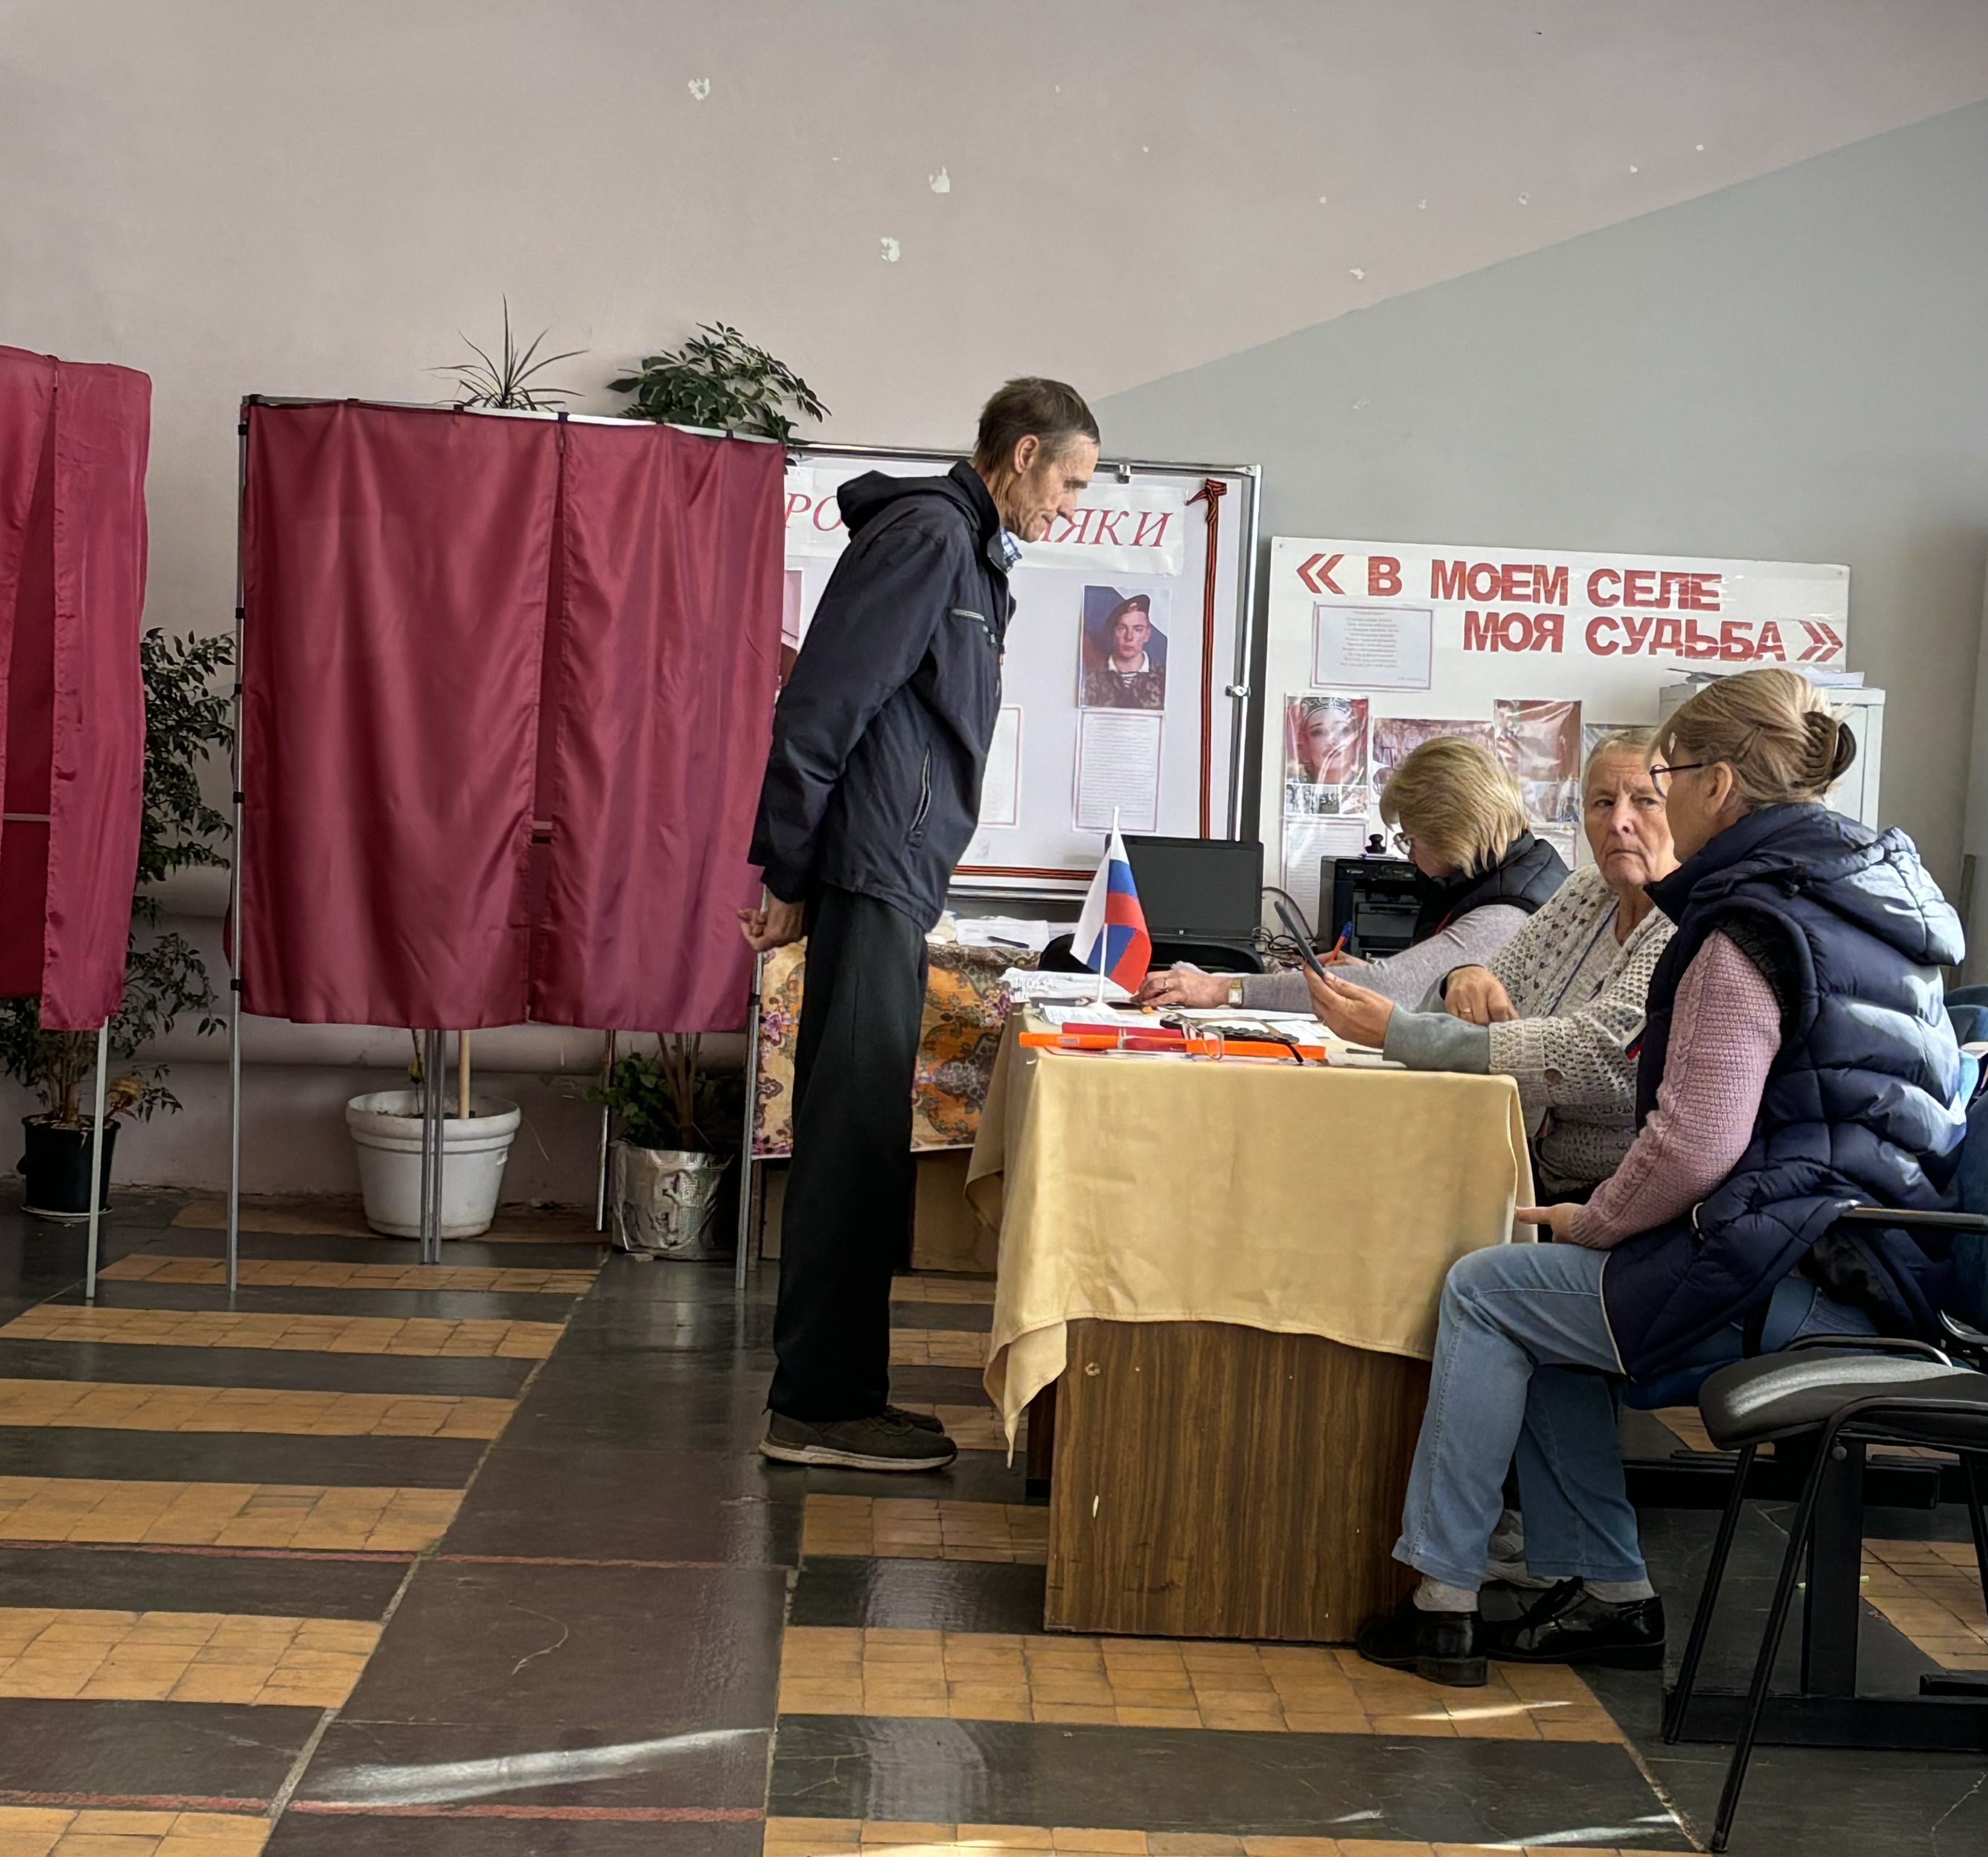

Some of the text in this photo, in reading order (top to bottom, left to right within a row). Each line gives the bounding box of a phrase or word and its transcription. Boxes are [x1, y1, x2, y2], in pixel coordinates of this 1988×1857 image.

[1040, 508, 1174, 547] ЯКИ
[1430, 559, 1569, 606] МОЕМ
[1586, 568, 1723, 611] СЕЛЕ
[1463, 610, 1565, 653] МОЯ
